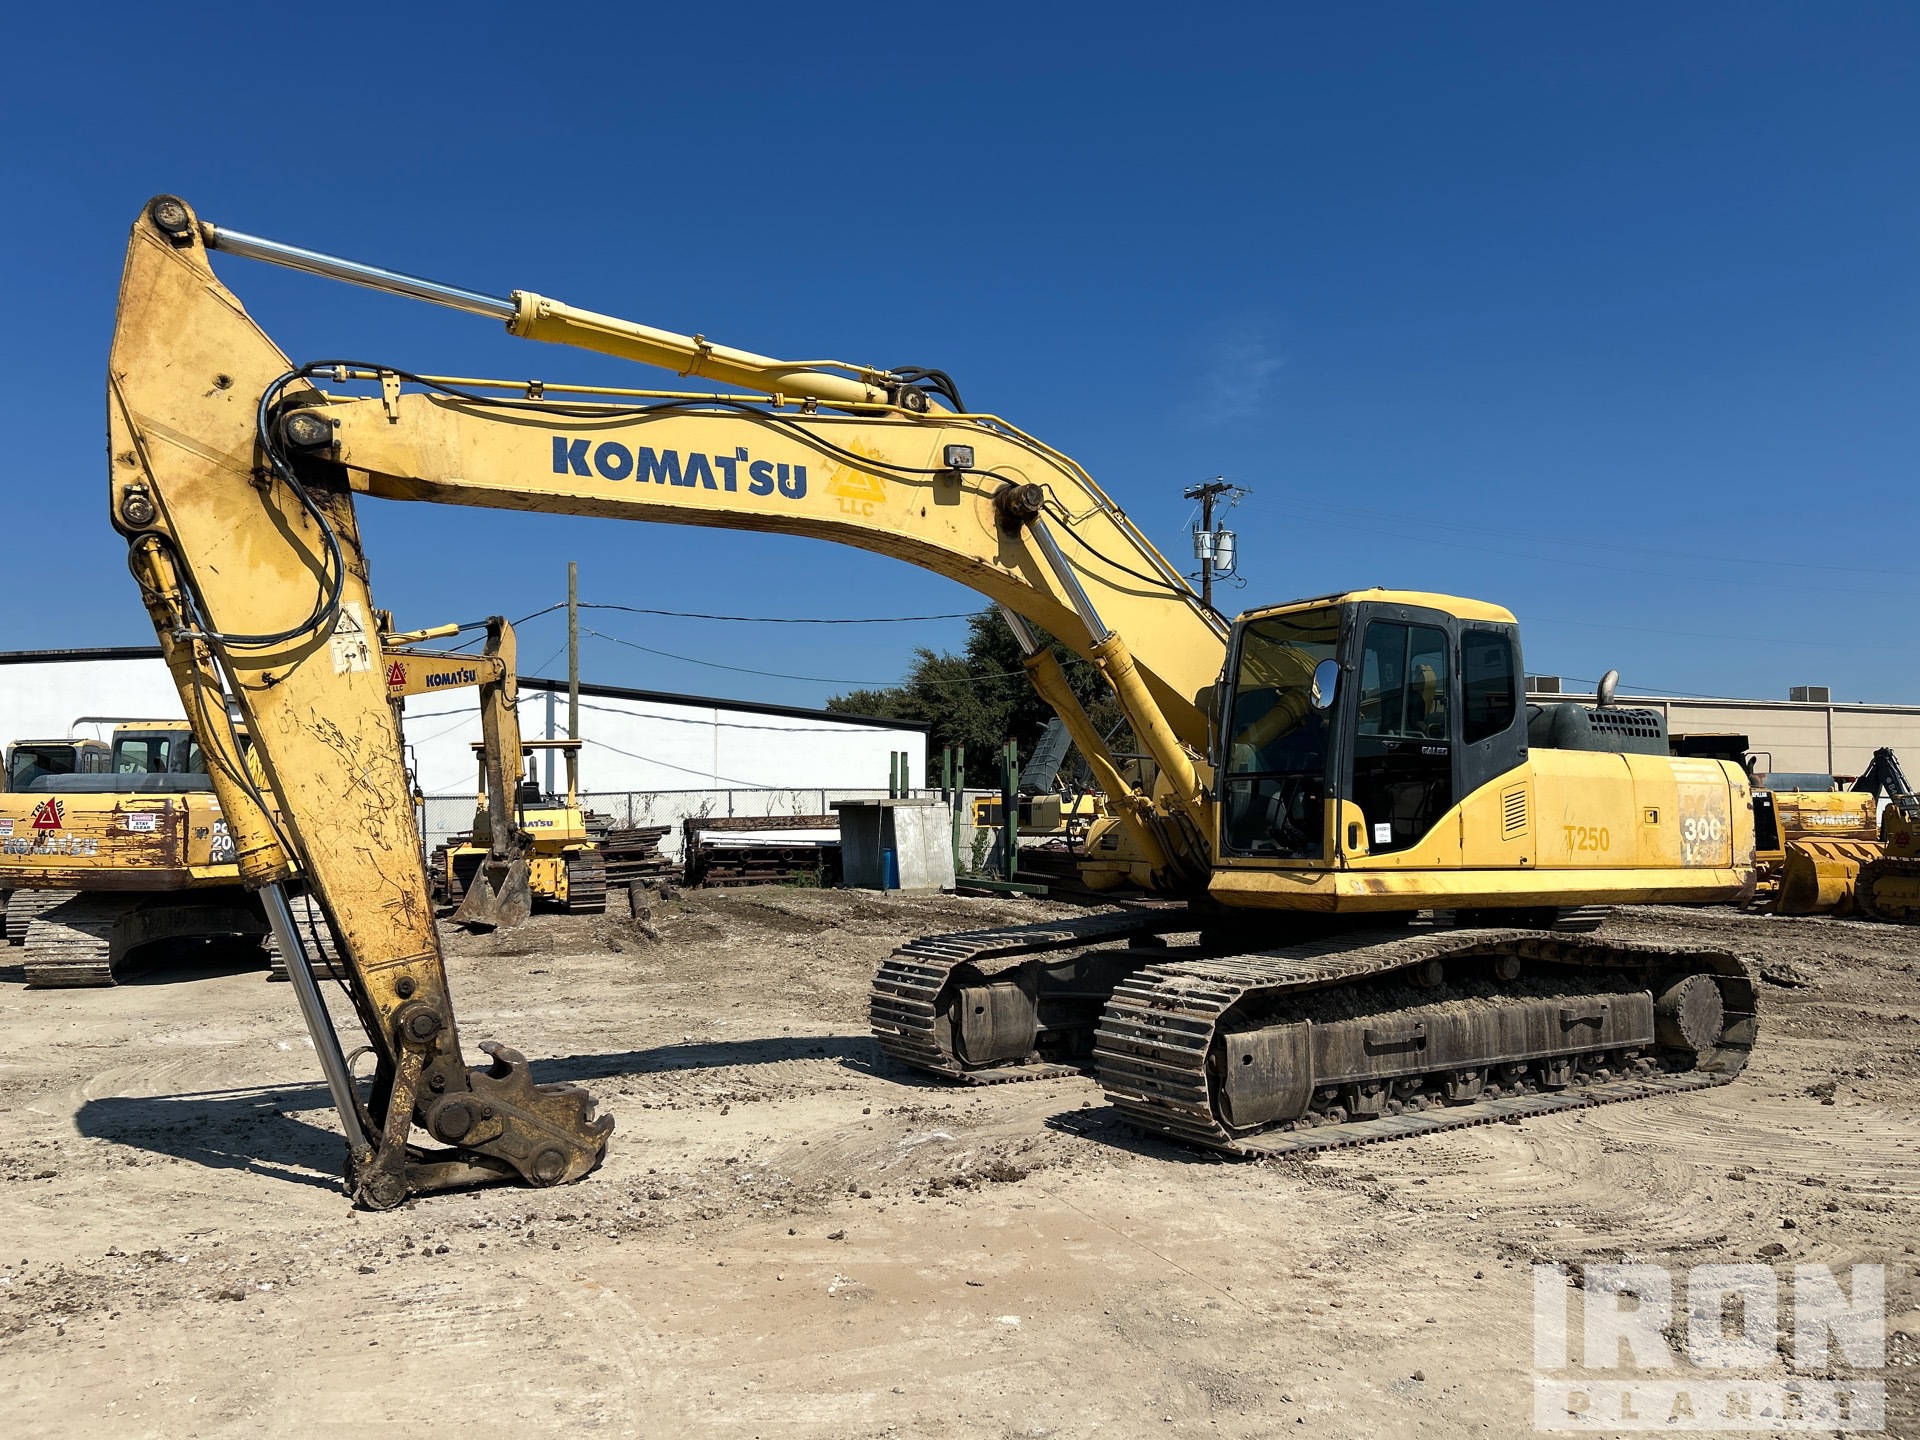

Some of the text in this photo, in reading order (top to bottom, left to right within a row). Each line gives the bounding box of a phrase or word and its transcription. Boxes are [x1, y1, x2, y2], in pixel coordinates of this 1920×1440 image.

[552, 436, 808, 500] KOMATSU
[839, 498, 875, 517] LLC
[426, 667, 476, 687] KOMATSU
[30, 801, 46, 818] TRI
[55, 800, 66, 821] DAL
[1563, 825, 1611, 851] T250
[1684, 817, 1722, 841] 300
[212, 835, 236, 851] 20
[212, 852, 224, 862] LC
